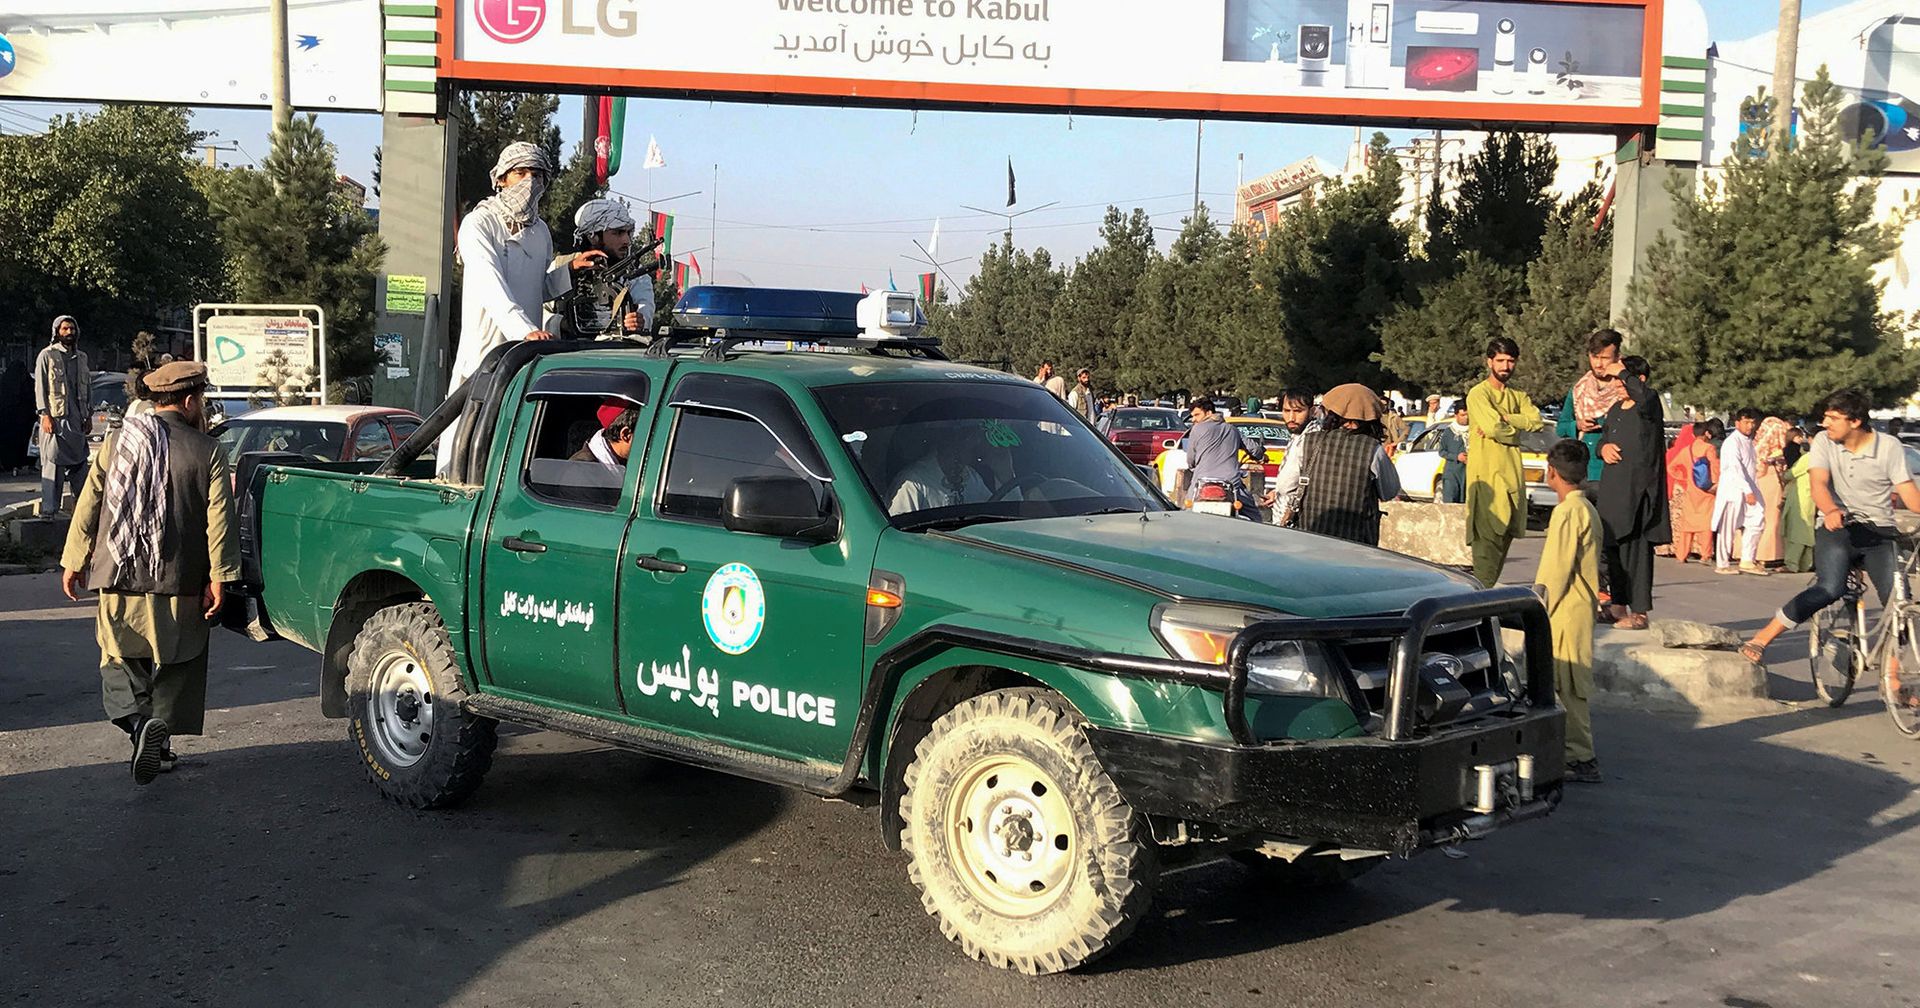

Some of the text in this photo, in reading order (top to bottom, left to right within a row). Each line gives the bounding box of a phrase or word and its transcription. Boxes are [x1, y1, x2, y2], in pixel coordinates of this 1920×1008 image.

[562, 0, 638, 38] LG
[923, 0, 956, 18] to
[966, 0, 1050, 22] Kabul
[773, 23, 1051, 69] به کابل خوش آمدید
[636, 643, 719, 719] پولیس
[732, 680, 836, 727] POLICE
